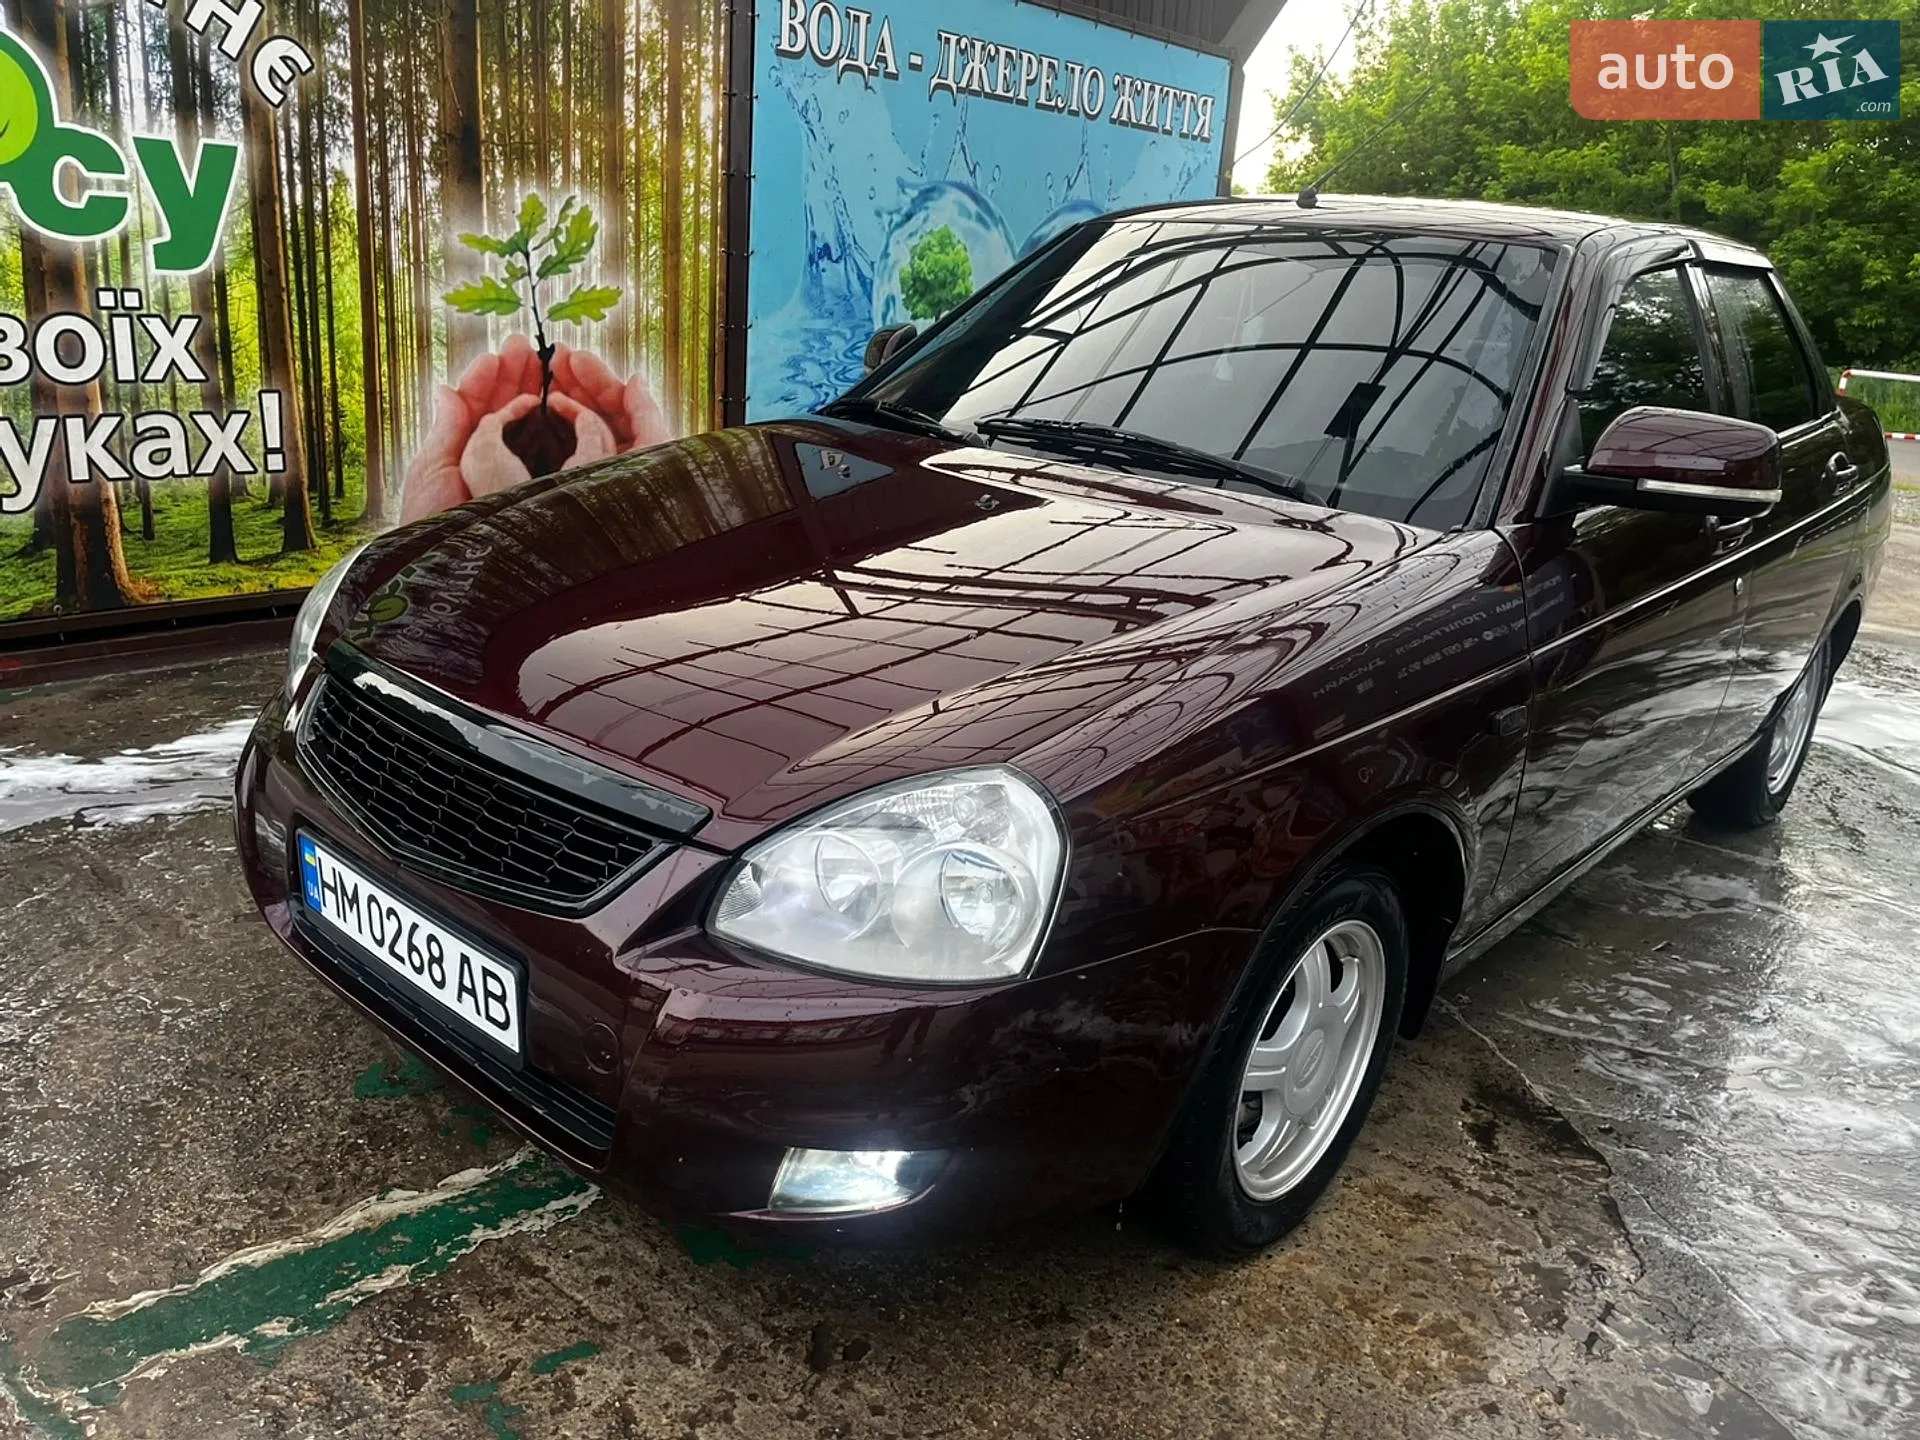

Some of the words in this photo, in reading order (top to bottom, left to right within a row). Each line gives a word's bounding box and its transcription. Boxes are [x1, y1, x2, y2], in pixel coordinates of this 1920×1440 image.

[144, 0, 314, 108] нє
[775, 0, 899, 88] ВОДА
[908, 53, 923, 71] -
[929, 30, 1106, 120] ДЖЕРЕЛО
[1110, 73, 1215, 142] ЖИТТЯ
[0, 389, 287, 513] уках!
[318, 856, 363, 934] HM
[366, 893, 447, 991] 0268
[456, 951, 511, 1032] AB
